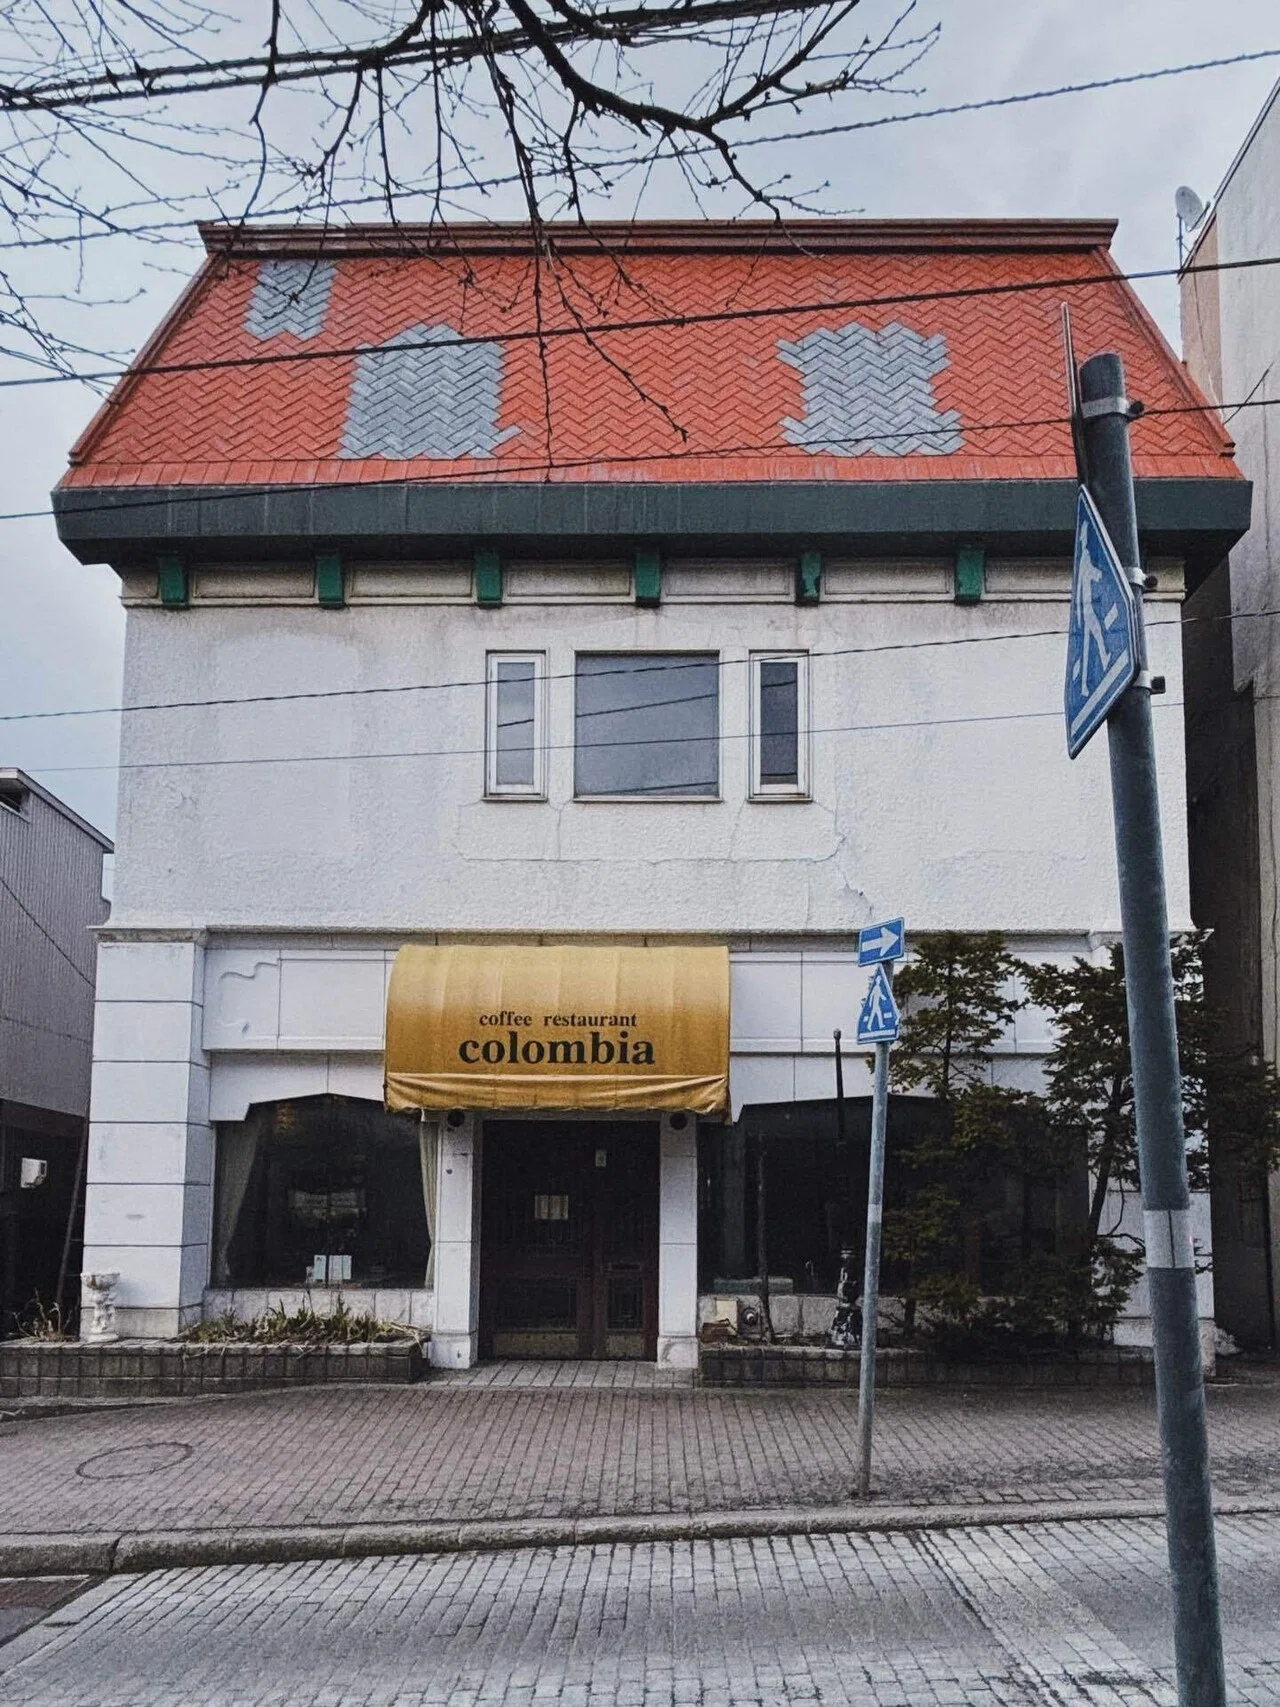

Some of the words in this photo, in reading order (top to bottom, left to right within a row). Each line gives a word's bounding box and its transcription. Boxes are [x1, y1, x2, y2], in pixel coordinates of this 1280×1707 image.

[479, 1011, 532, 1027] coffee
[543, 1013, 638, 1027] restaurant
[459, 1031, 655, 1065] colombia
